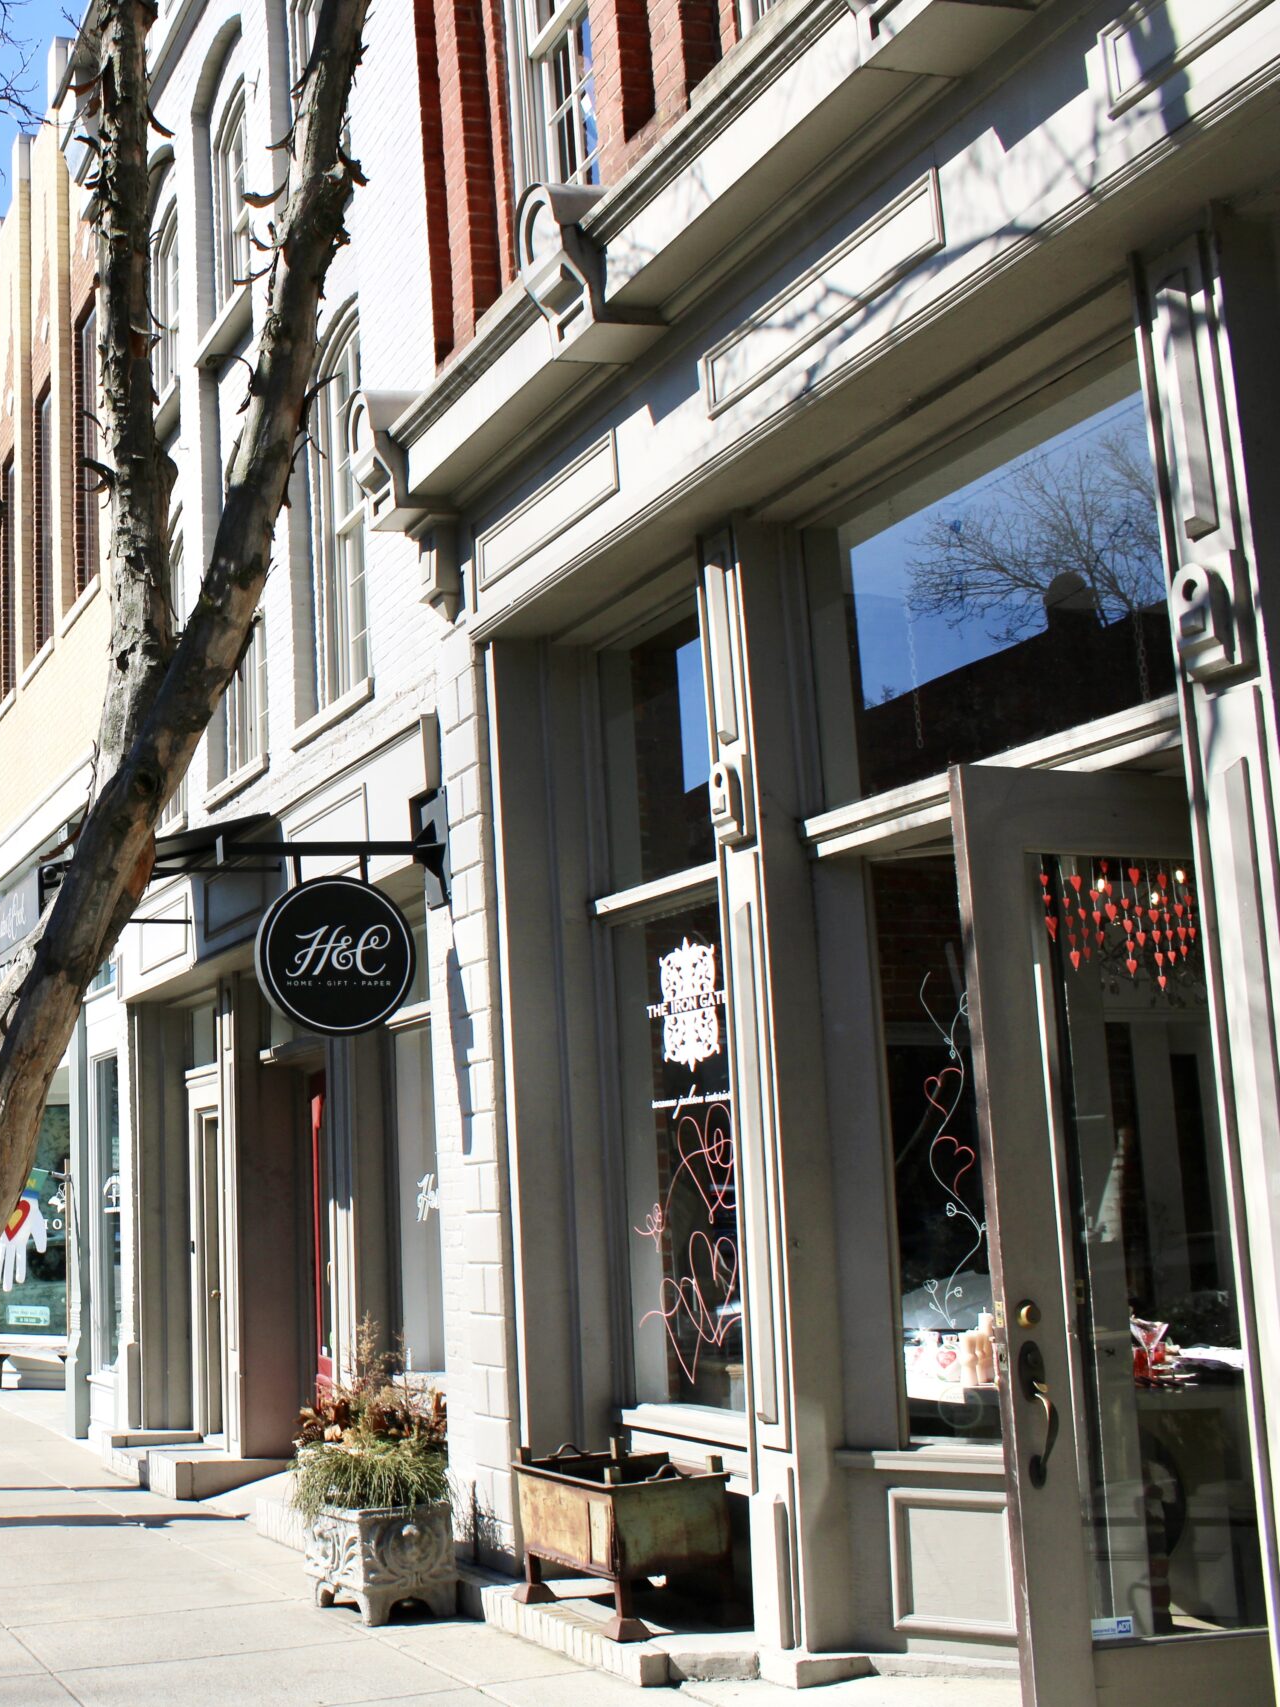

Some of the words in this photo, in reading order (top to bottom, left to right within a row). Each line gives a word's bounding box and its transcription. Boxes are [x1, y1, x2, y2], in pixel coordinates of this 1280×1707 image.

[285, 924, 391, 977] H&C
[646, 1002, 669, 1019] THE
[670, 995, 697, 1014] IRON
